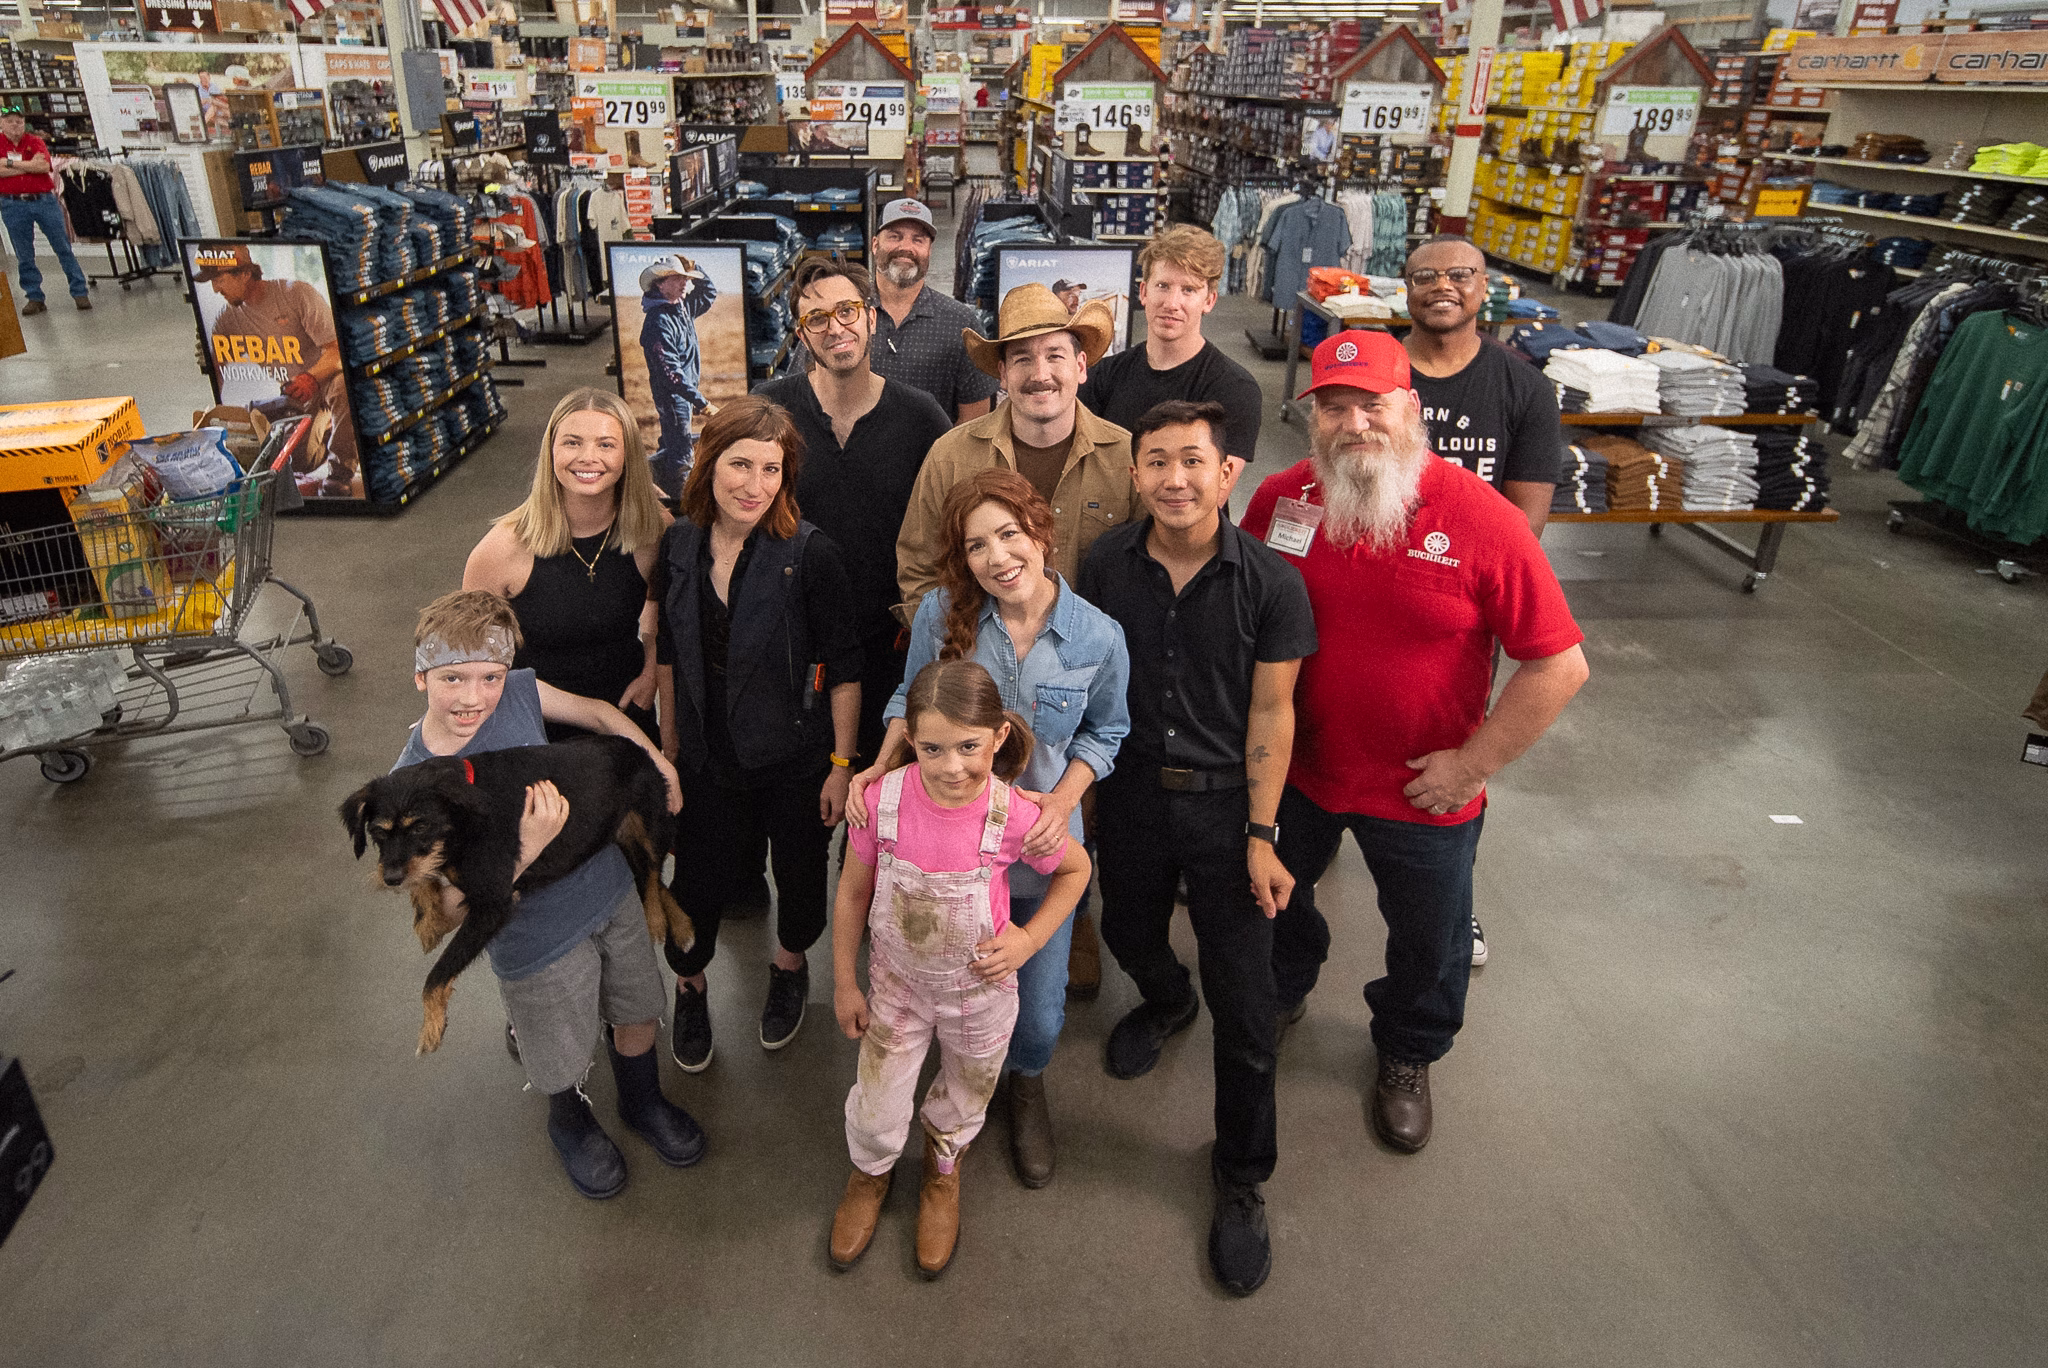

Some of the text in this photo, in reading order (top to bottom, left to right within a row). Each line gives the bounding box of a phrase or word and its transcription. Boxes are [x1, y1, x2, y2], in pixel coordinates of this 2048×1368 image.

[1797, 53, 1900, 70] carhartt
[606, 101, 666, 124] 279 99
[845, 103, 905, 126] 294 99
[1092, 104, 1151, 128] 146 99
[1362, 105, 1419, 129] 169 99
[1633, 108, 1674, 131] 189
[249, 161, 272, 176] REBAR
[378, 154, 405, 169] ARIAT
[194, 249, 236, 259] ARIAT
[629, 255, 669, 263] ARIAT
[1018, 259, 1058, 268] ARIAT
[212, 334, 304, 364] REBAR
[219, 364, 290, 382] WORKWEAR
[1423, 407, 1470, 430] RN &
[107, 420, 132, 449] NOBLE
[1438, 437, 1497, 451] LOUIS
[1443, 456, 1496, 482] E
